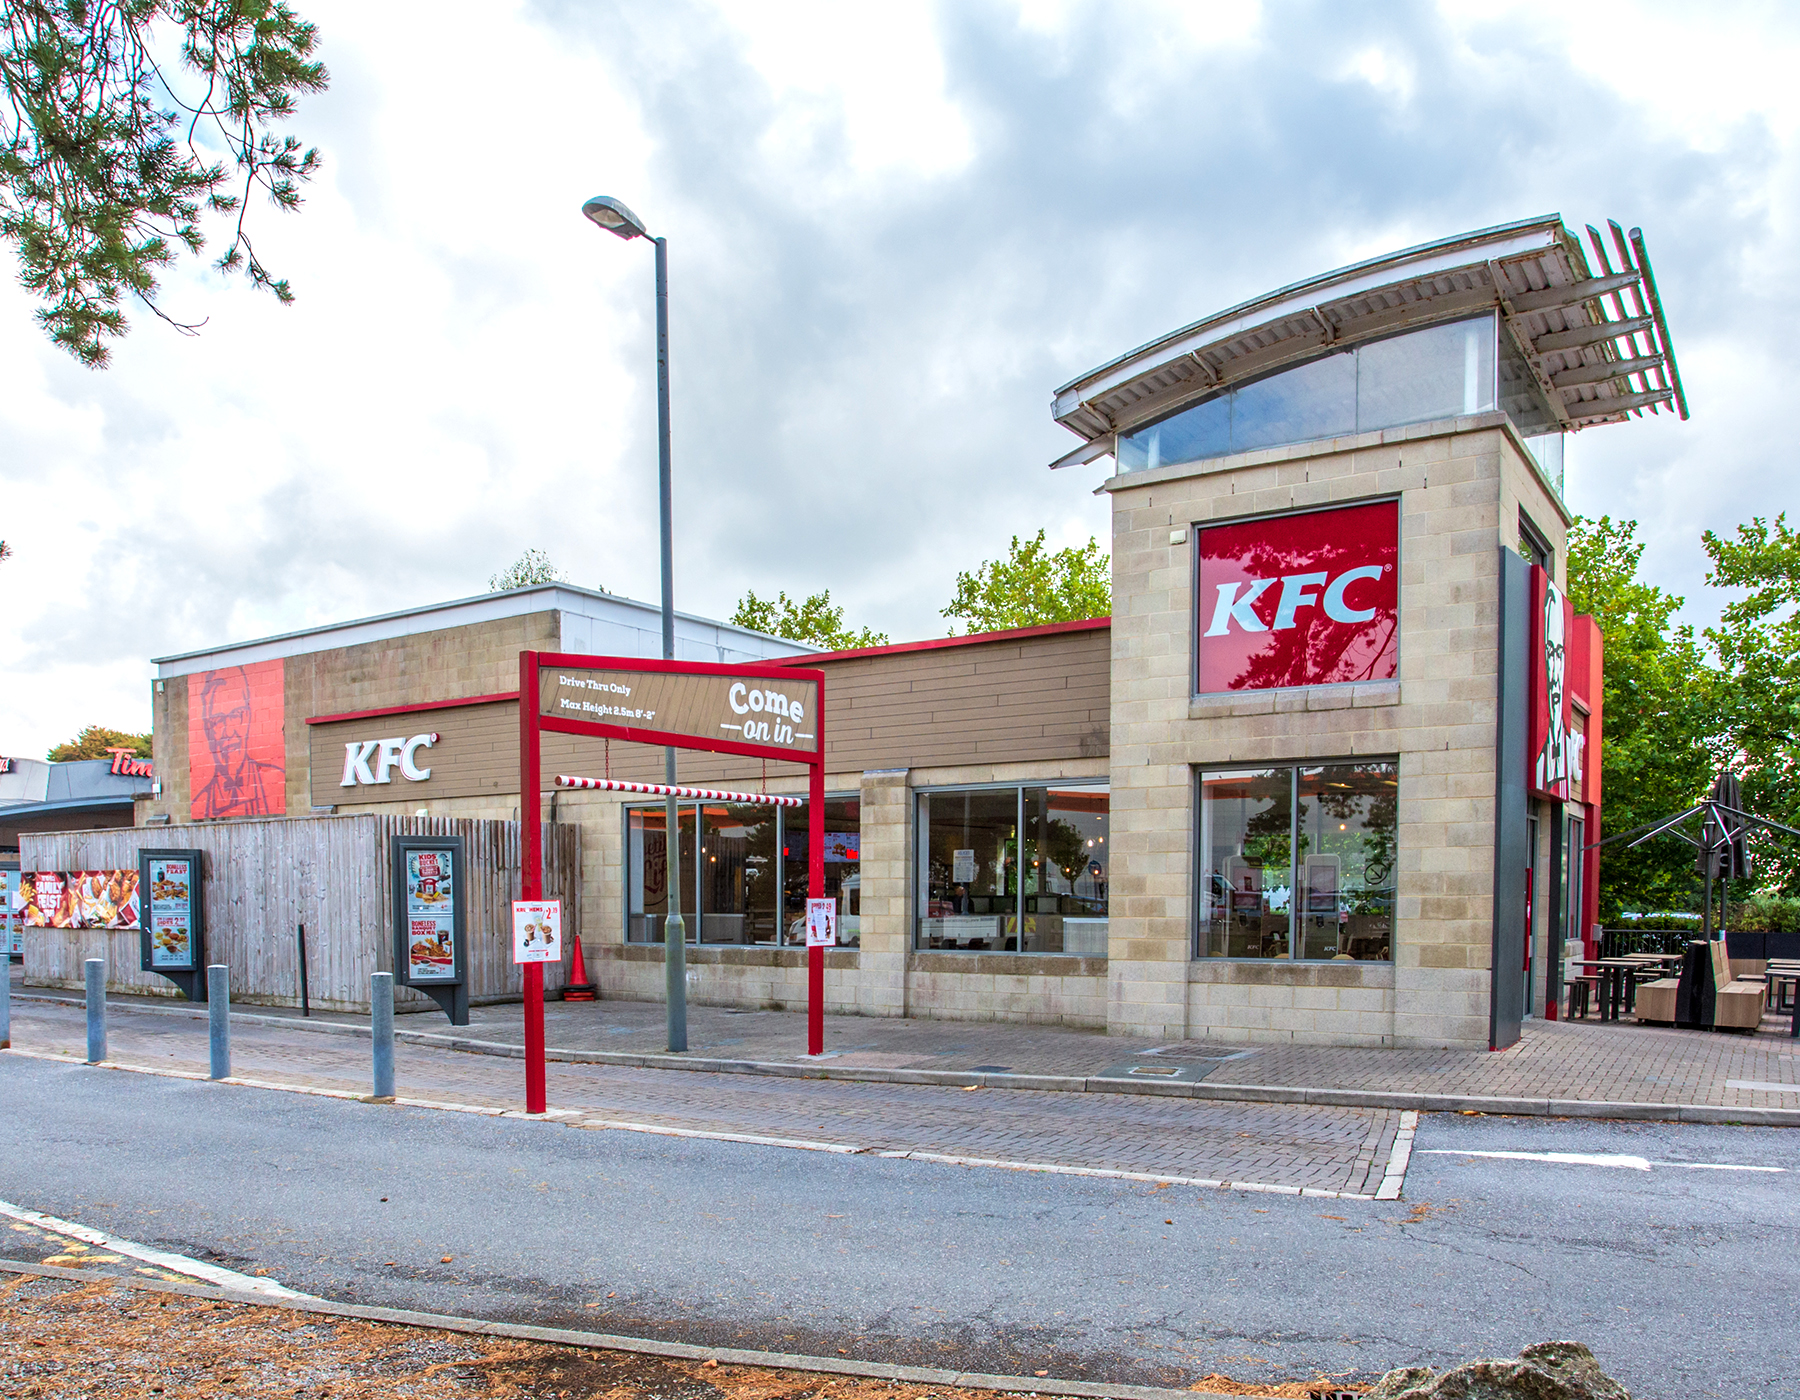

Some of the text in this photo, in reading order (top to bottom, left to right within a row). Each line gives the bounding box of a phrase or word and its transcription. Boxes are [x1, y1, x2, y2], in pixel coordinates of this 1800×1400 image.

[1203, 565, 1384, 637] KFC
[559, 675, 631, 697] Drive Thru Only
[560, 698, 581, 710] Max
[582, 701, 612, 716] Height
[613, 705, 634, 718] 2.5m
[729, 682, 804, 724] Come
[743, 717, 795, 744] on in
[105, 747, 153, 778] Tim
[340, 734, 433, 787] KFC
[36, 881, 63, 895] FAMILY
[37, 895, 62, 909] FEAST
